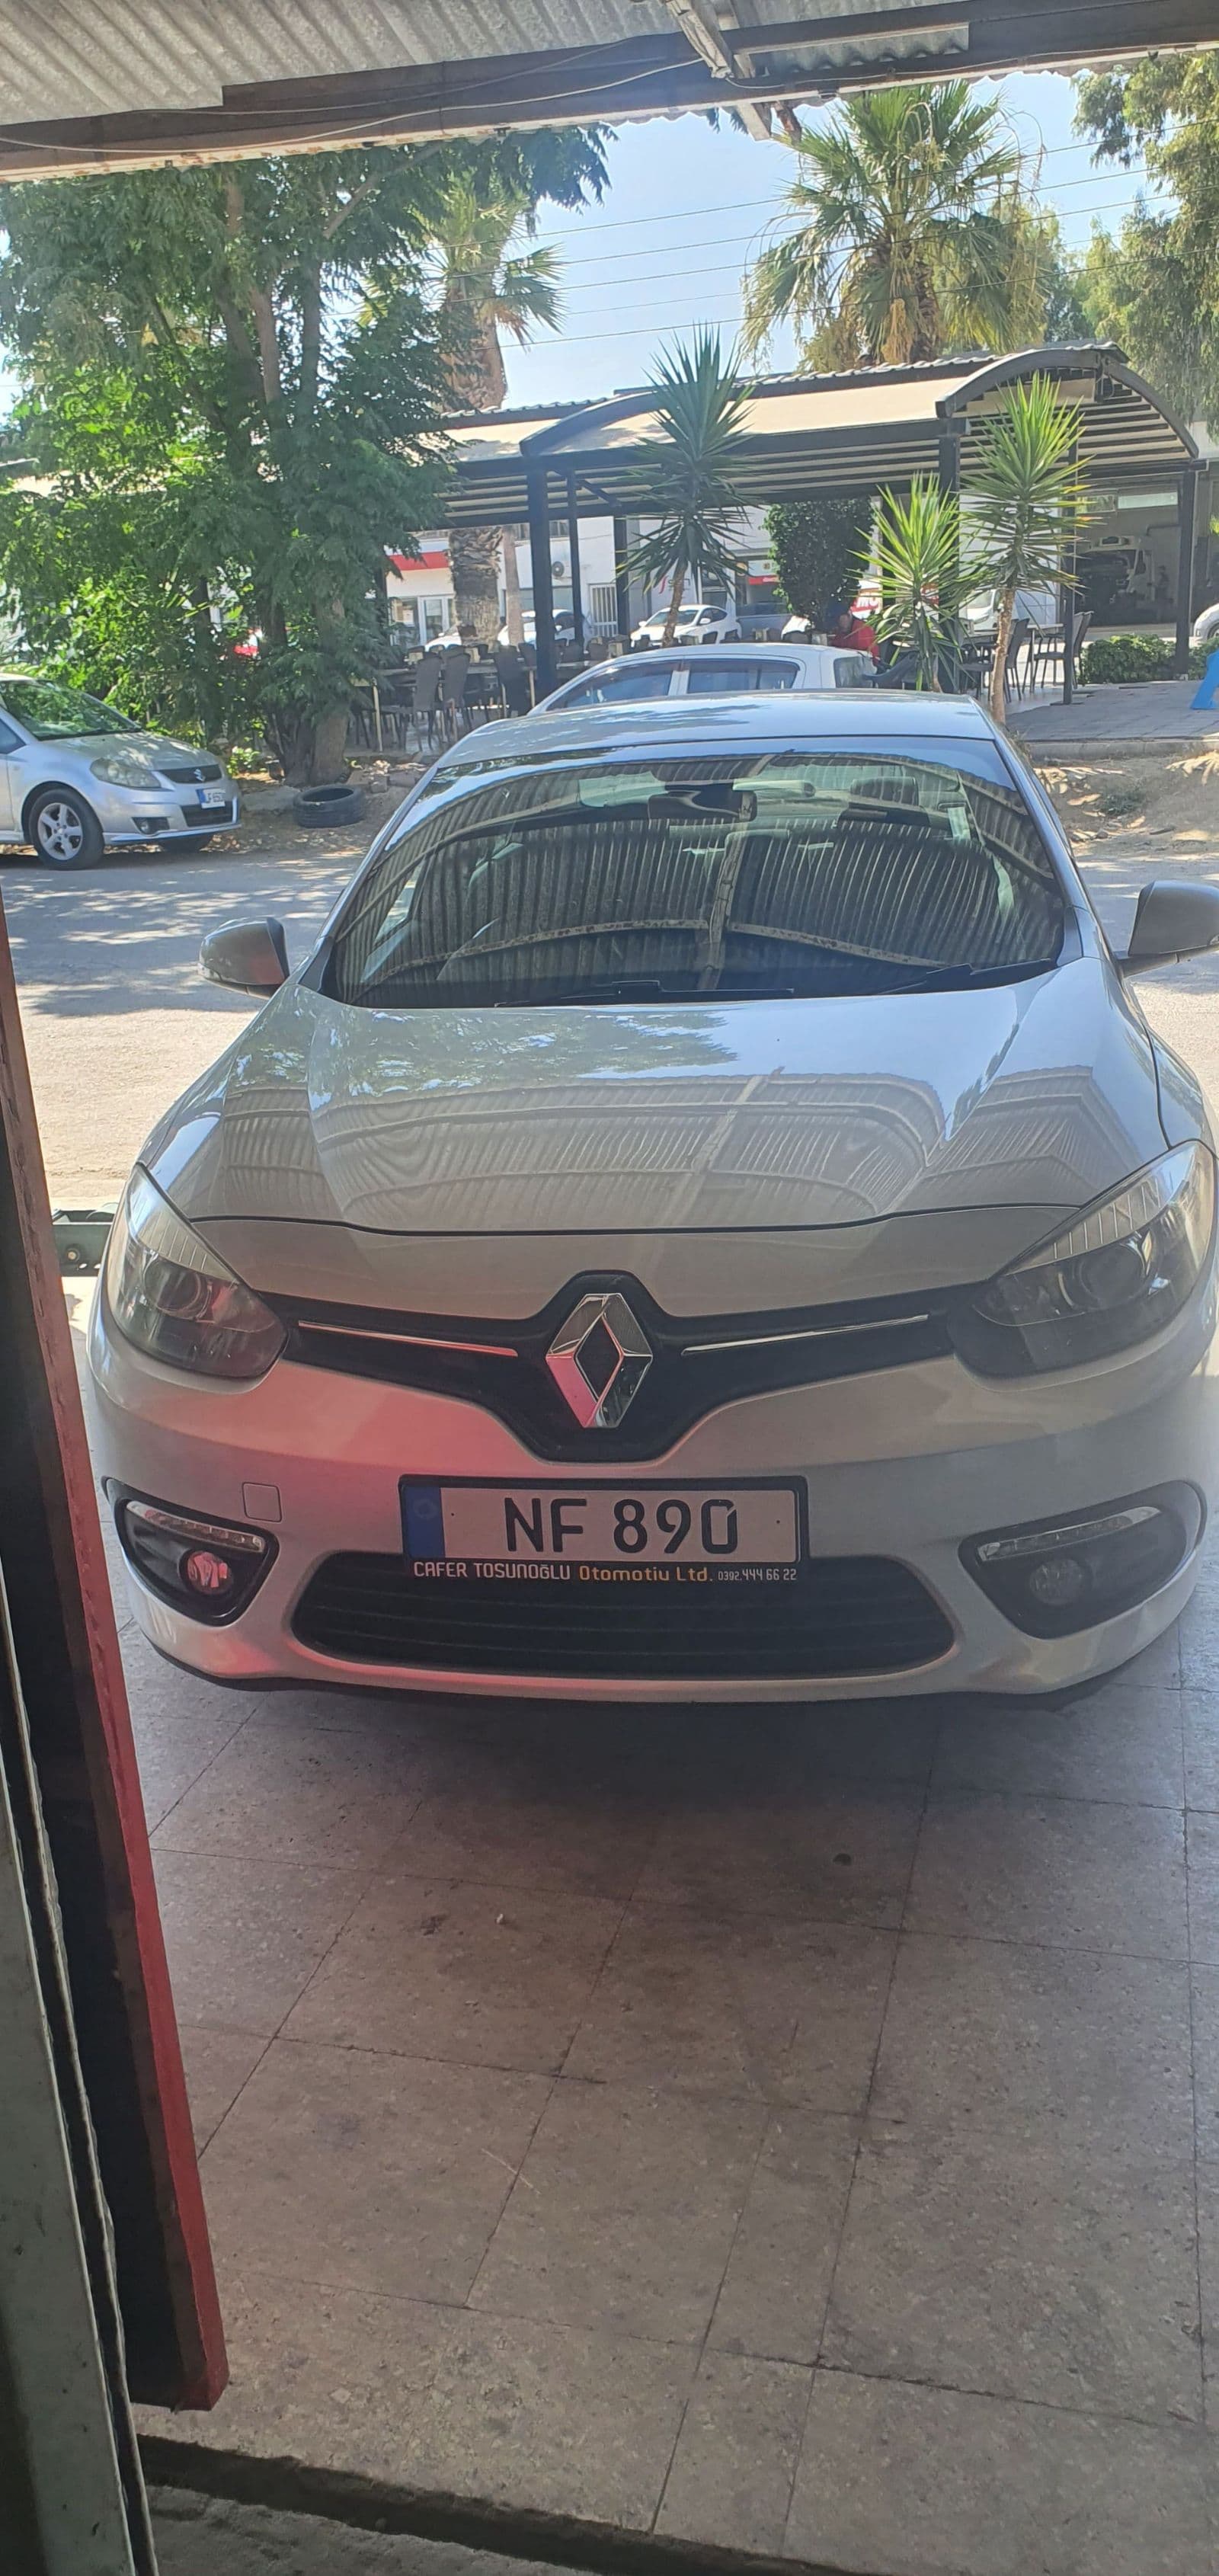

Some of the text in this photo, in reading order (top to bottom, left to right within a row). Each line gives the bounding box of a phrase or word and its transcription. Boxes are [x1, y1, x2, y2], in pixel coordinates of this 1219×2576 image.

[504, 1497, 738, 1554] NF 890
[414, 1561, 468, 1578] CAFER
[677, 1566, 713, 1582] Ltd.
[766, 1568, 780, 1581] 66
[782, 1568, 797, 1581] 22
